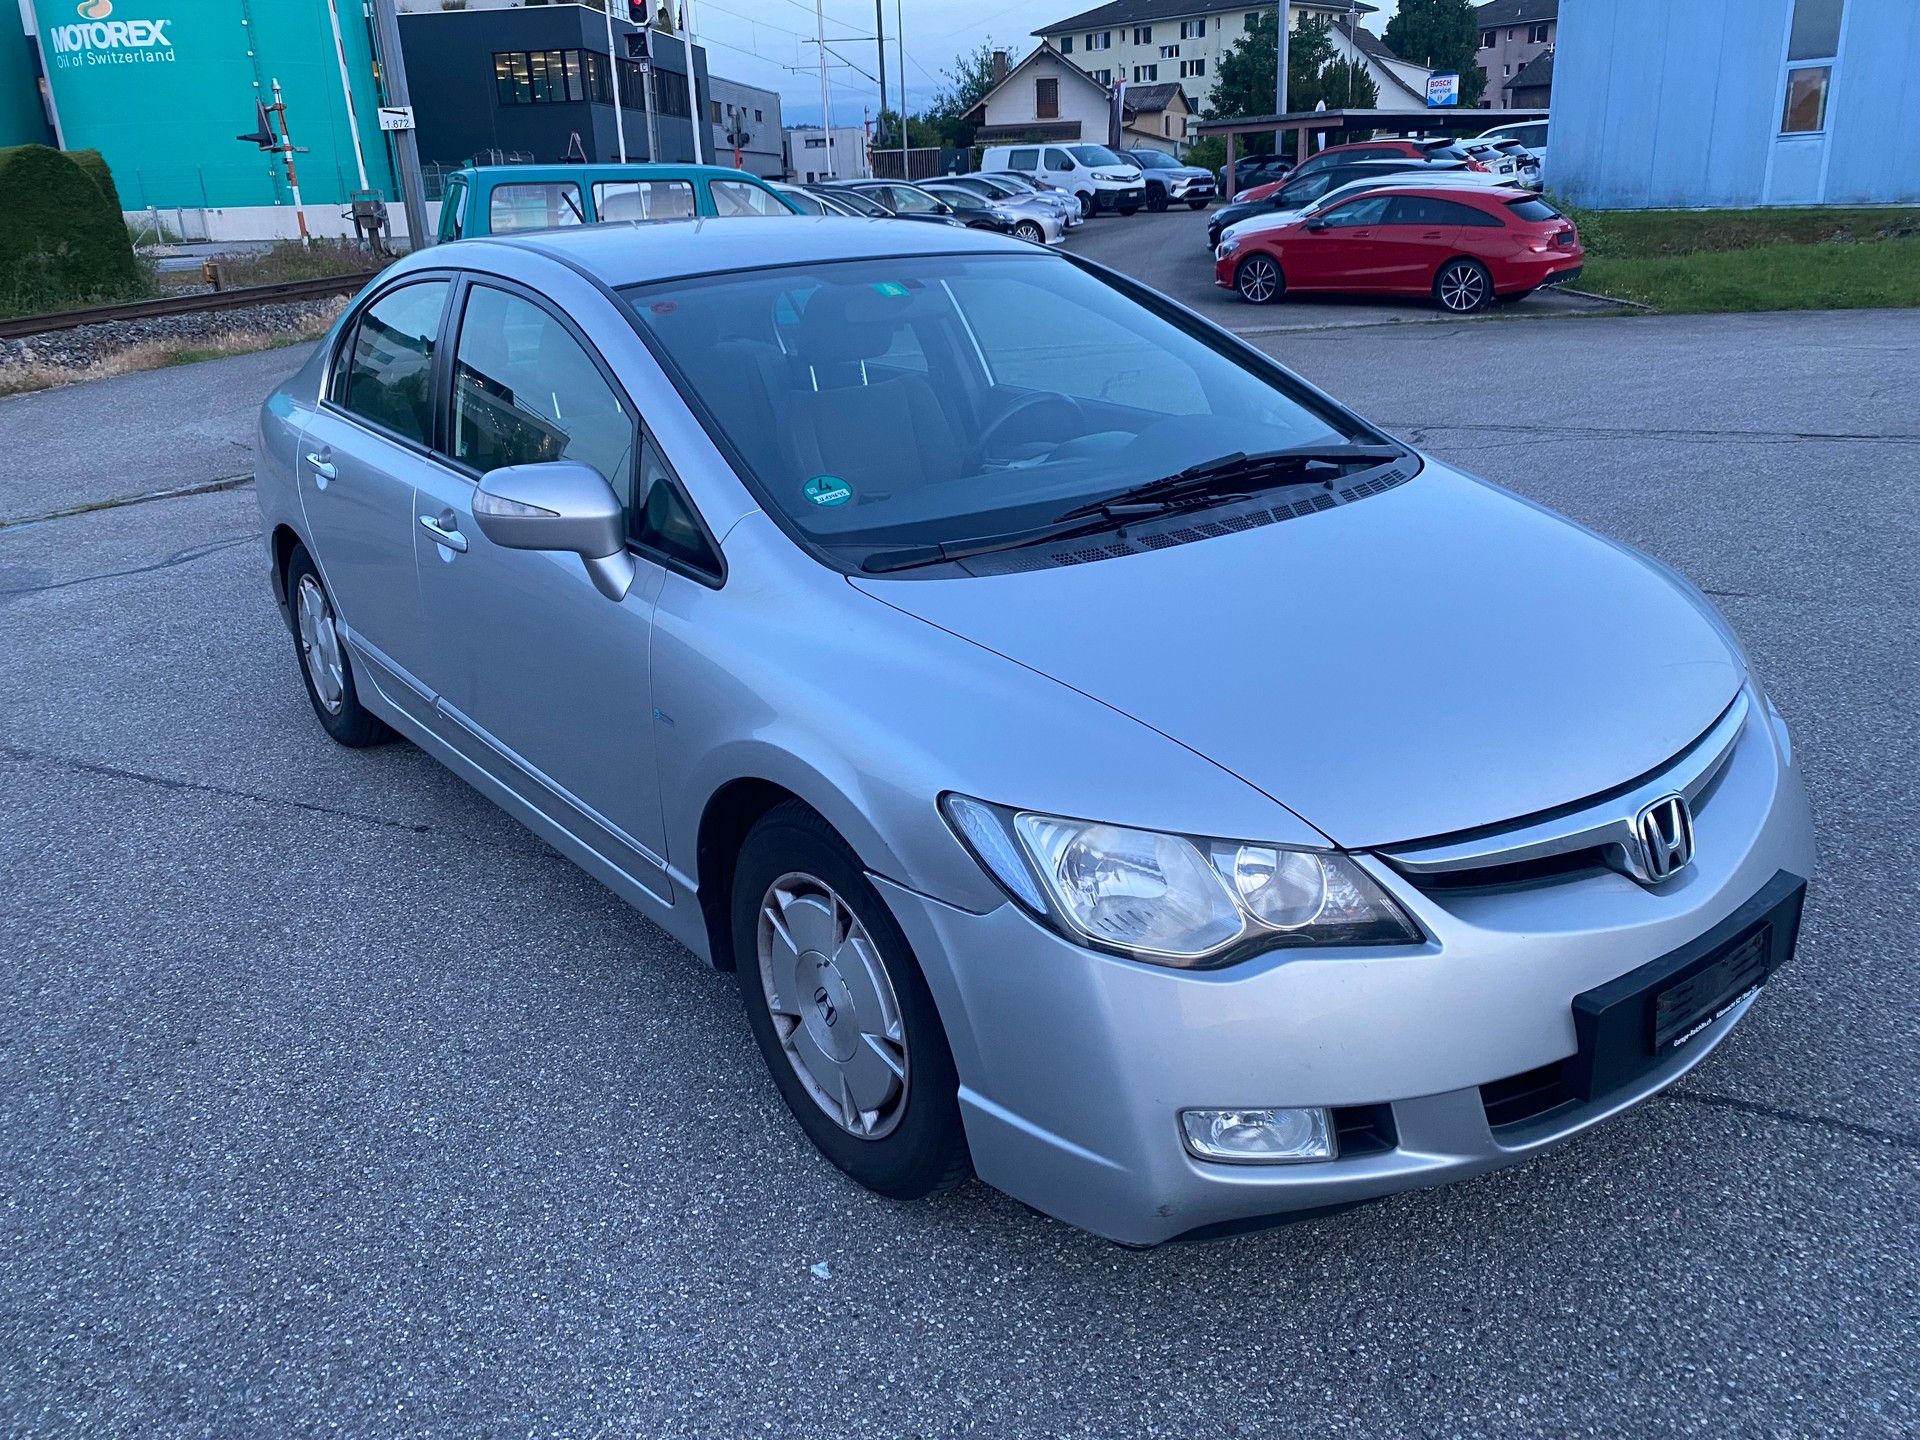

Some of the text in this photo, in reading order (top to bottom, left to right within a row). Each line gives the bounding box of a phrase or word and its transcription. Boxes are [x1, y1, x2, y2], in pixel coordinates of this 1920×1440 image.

[51, 20, 171, 53] MOTOREX
[56, 48, 176, 68] Oil of Switzerland
[1430, 79, 1452, 88] BOSCH
[1429, 87, 1452, 95] Service
[385, 119, 410, 129] 1.872
[818, 478, 832, 491] 4
